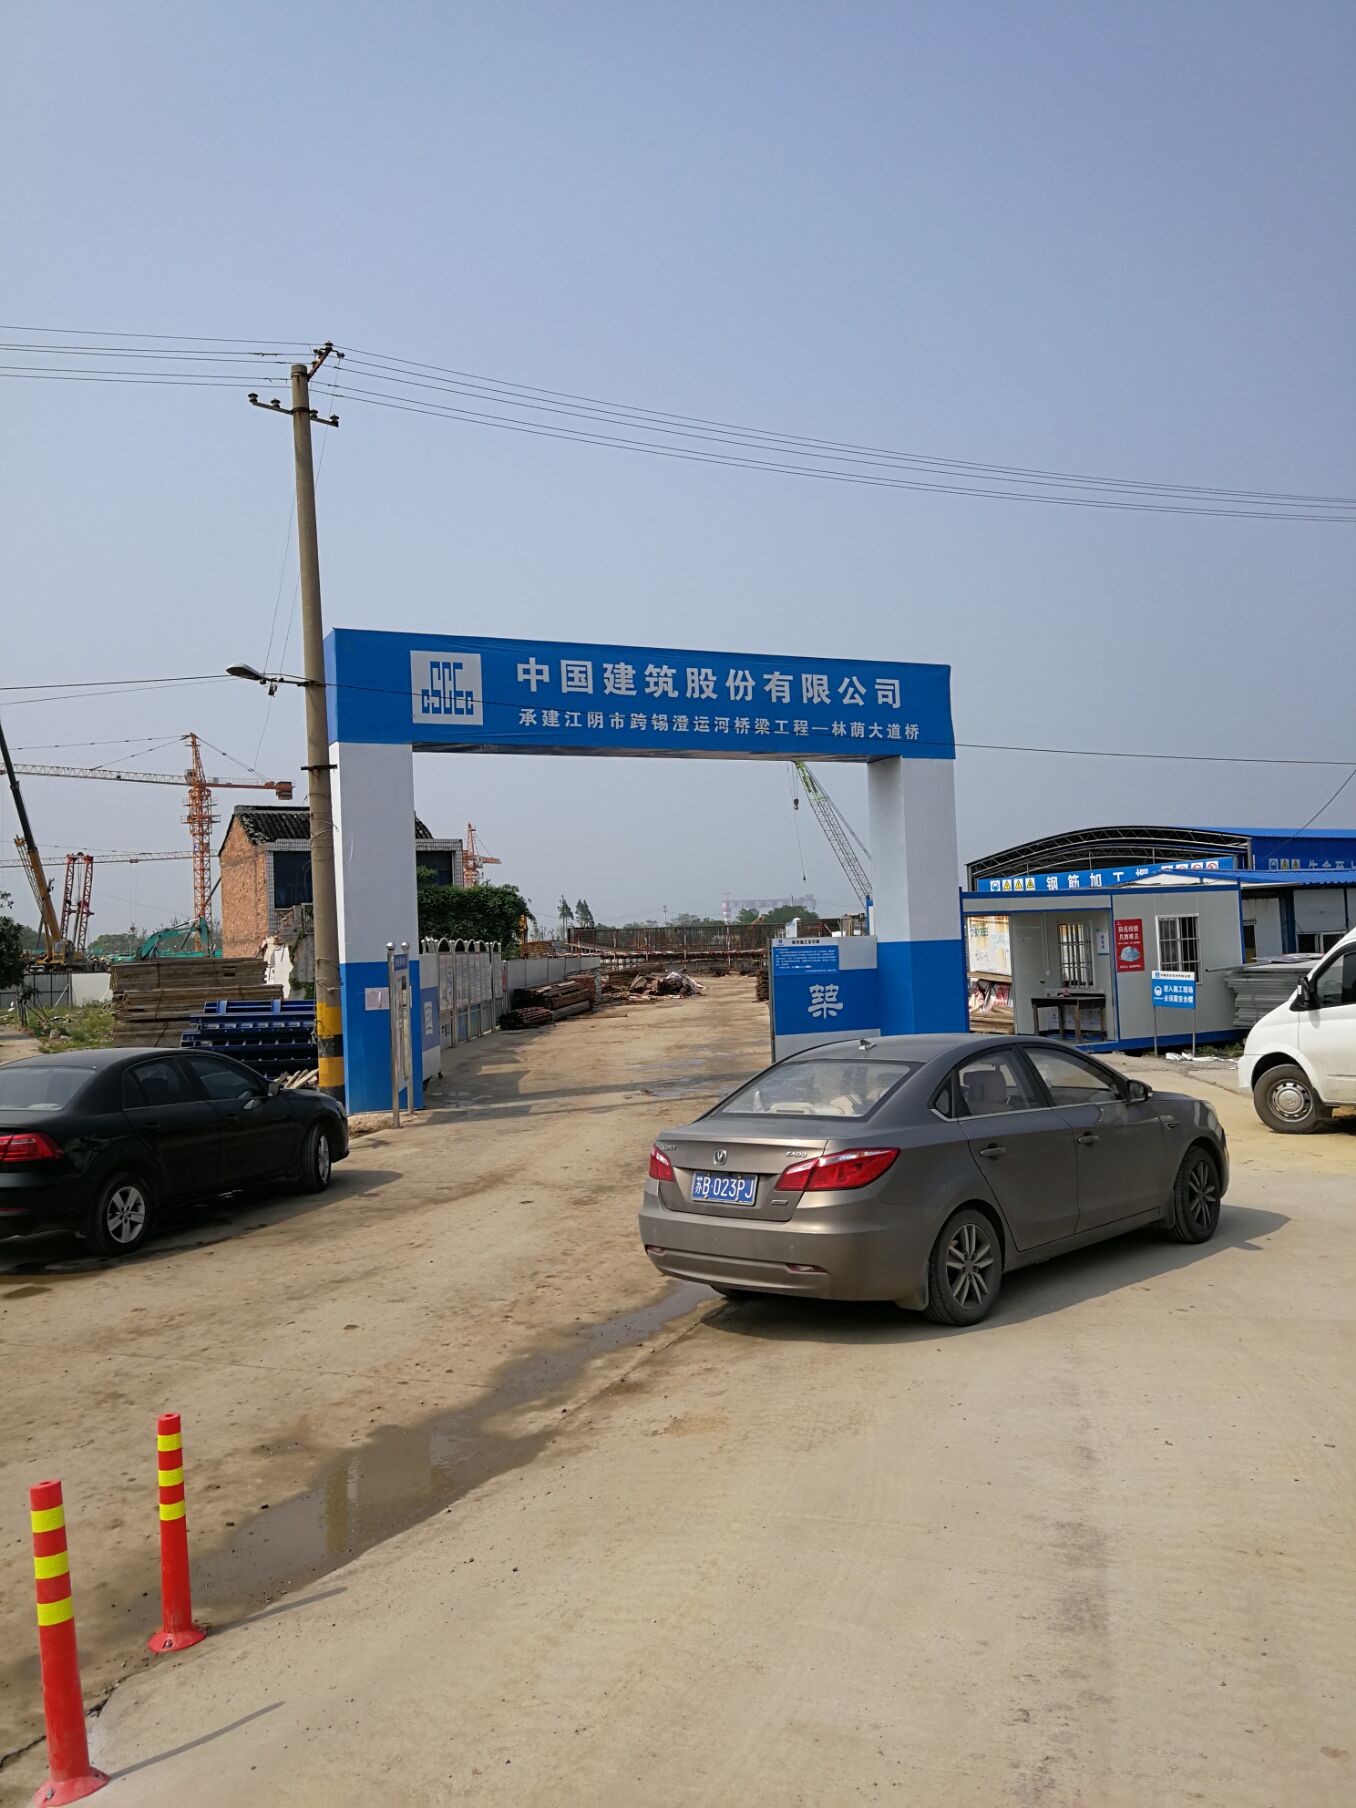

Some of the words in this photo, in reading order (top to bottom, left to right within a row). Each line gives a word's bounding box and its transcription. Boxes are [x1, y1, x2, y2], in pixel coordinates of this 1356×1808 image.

[516, 657, 903, 709] 中国建筑股份有限公司
